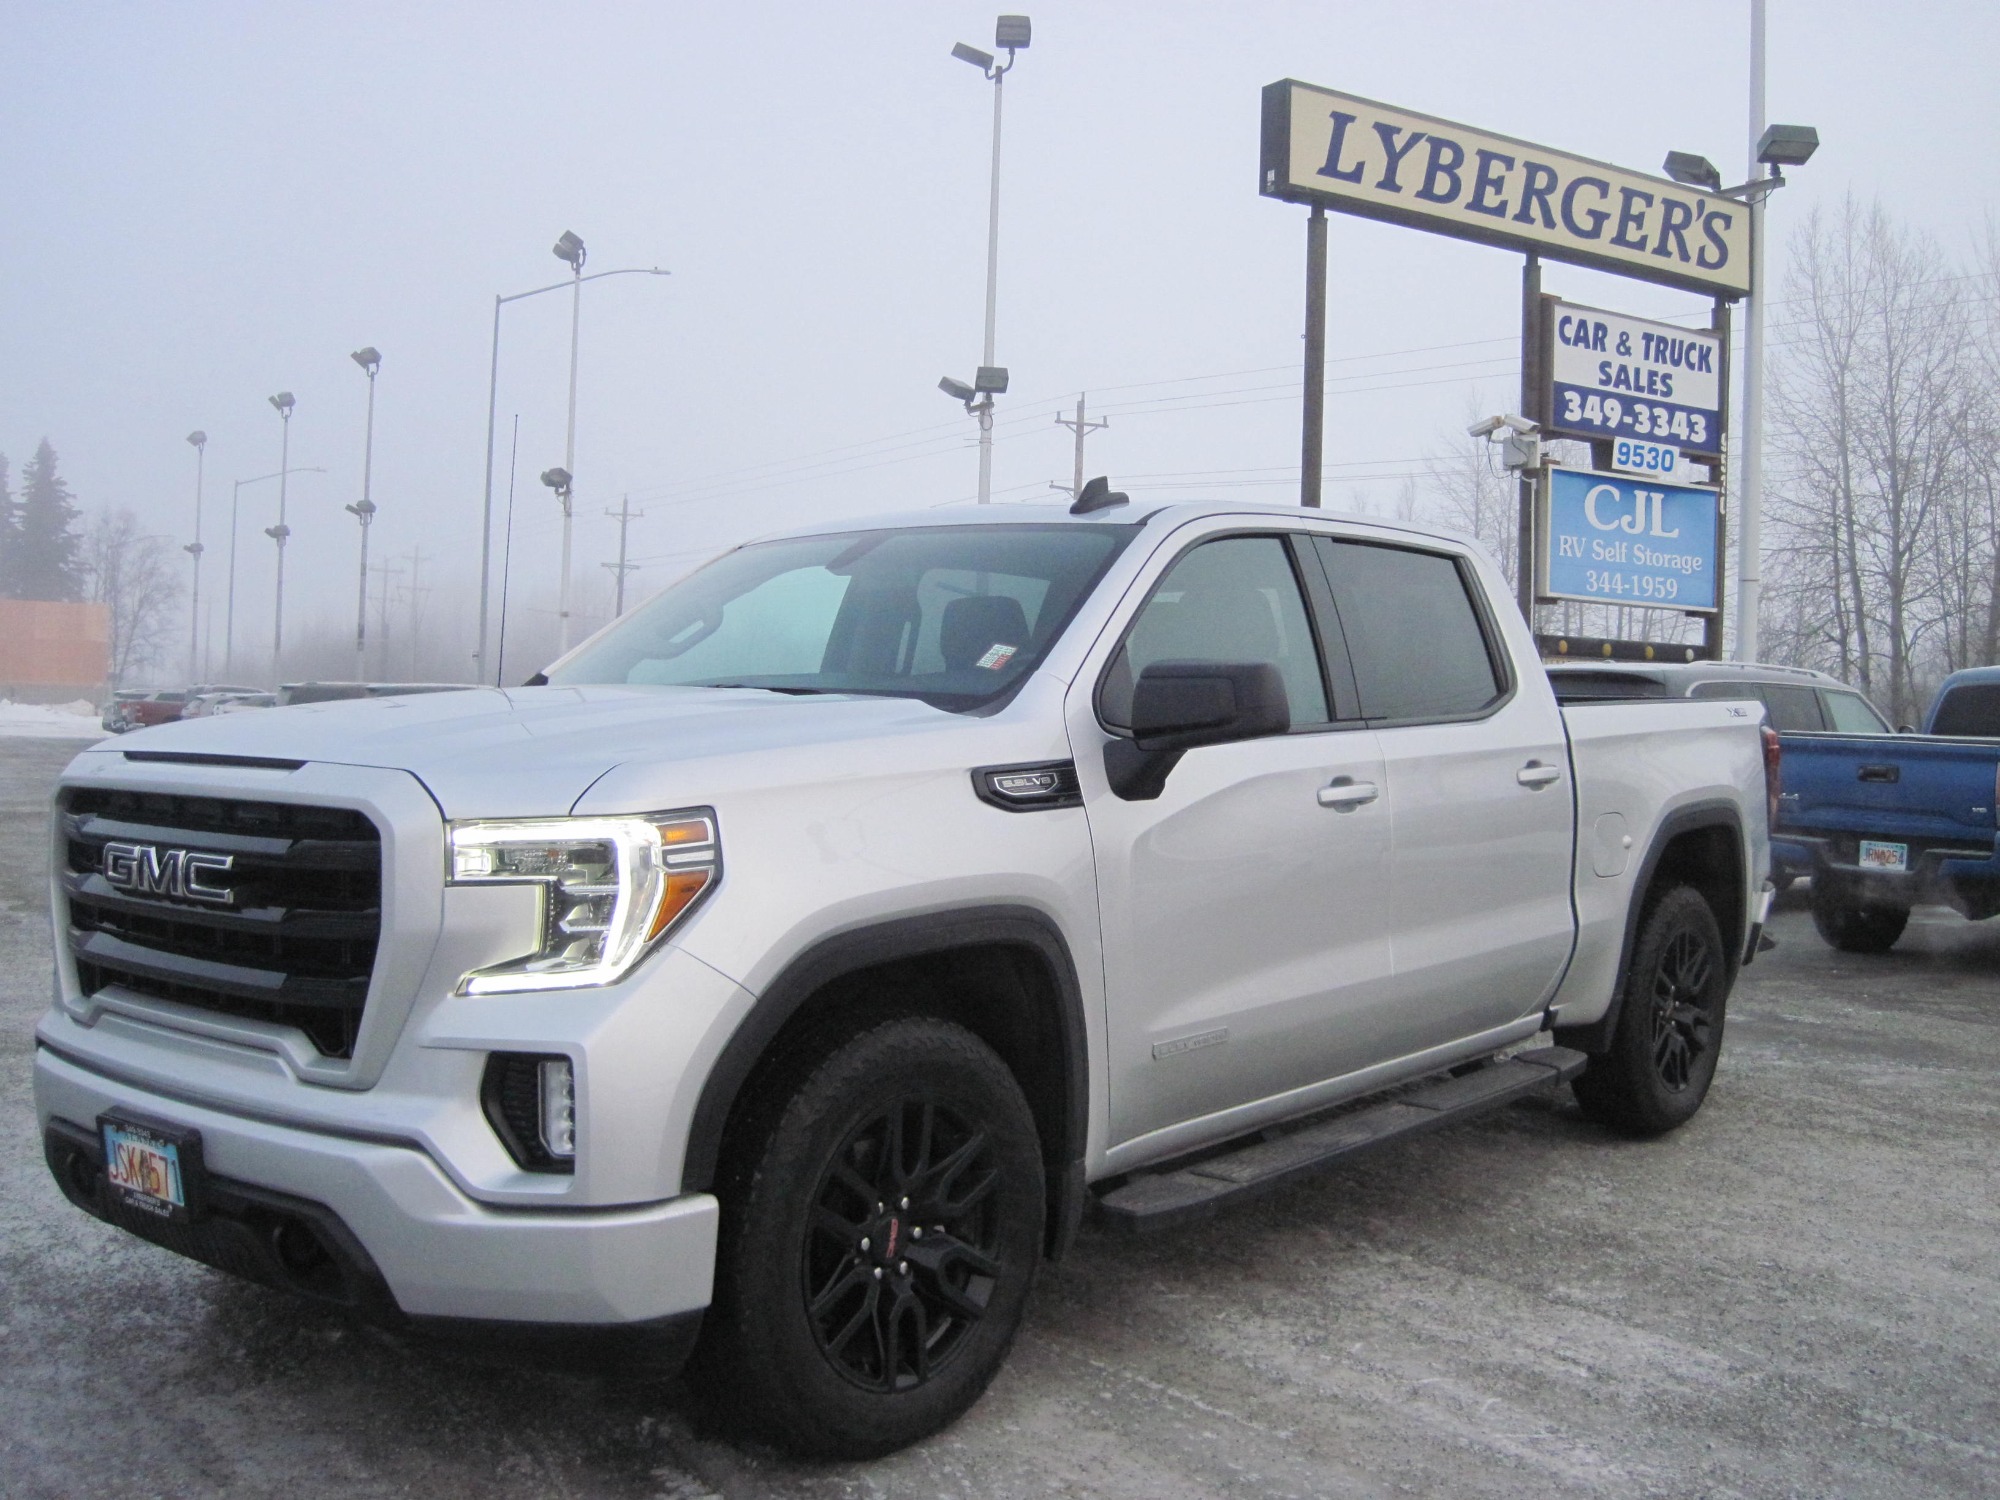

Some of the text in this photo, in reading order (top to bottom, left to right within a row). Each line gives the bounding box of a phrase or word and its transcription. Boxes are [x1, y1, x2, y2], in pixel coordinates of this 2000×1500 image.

[1316, 110, 1733, 270] LYBERGER'S
[1558, 315, 1712, 374] CAR & TRUCK
[1598, 361, 1674, 398] SALES
[1563, 391, 1707, 443] 349-3343
[1616, 442, 1675, 472] 9530
[1584, 484, 1680, 538] CJL
[1558, 535, 1703, 575] RV Self Storage
[1586, 570, 1678, 599] 344-1959
[103, 841, 234, 904] GMC
